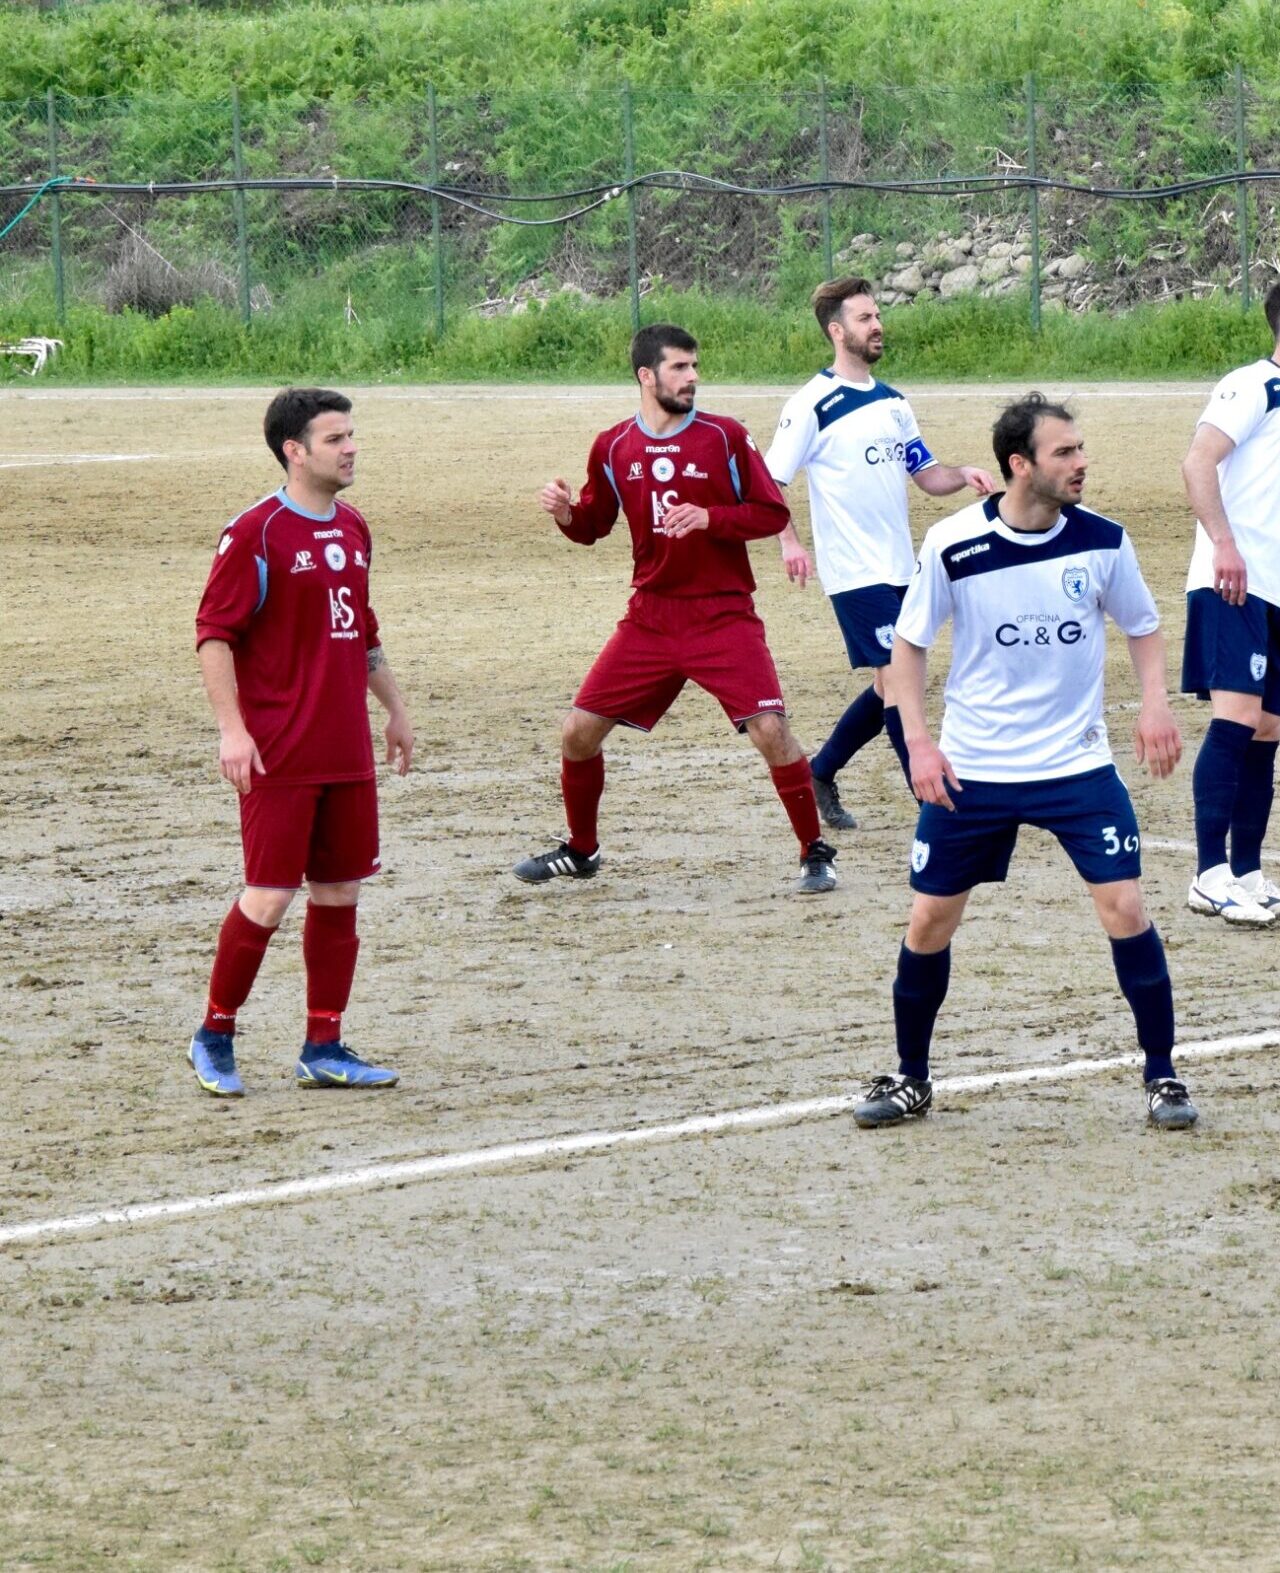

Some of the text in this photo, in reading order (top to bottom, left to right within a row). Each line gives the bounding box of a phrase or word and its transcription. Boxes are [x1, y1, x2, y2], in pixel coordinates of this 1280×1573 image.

[645, 444, 681, 454] macron
[950, 542, 990, 563] sportika
[1016, 614, 1061, 624] OFFICINA
